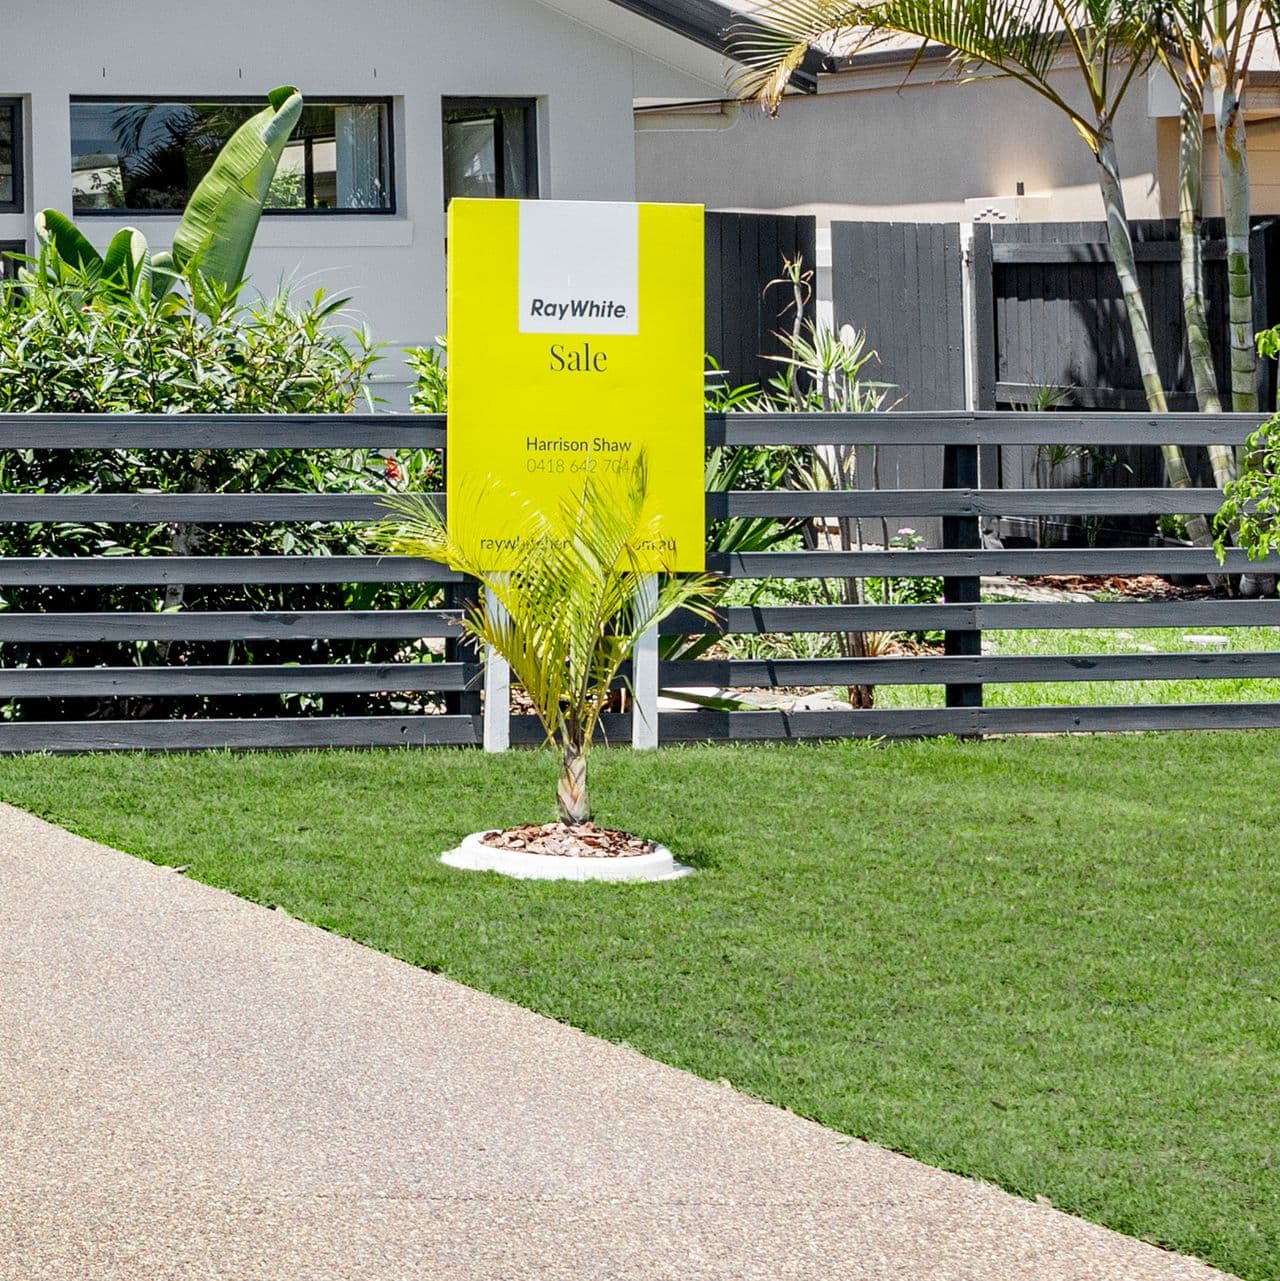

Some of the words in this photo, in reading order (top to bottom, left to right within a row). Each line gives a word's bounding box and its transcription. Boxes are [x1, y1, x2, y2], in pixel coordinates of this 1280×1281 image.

[549, 342, 608, 373] Sale
[526, 437, 589, 452] Harrison
[593, 437, 632, 452] Shaw
[526, 458, 565, 473] 0418
